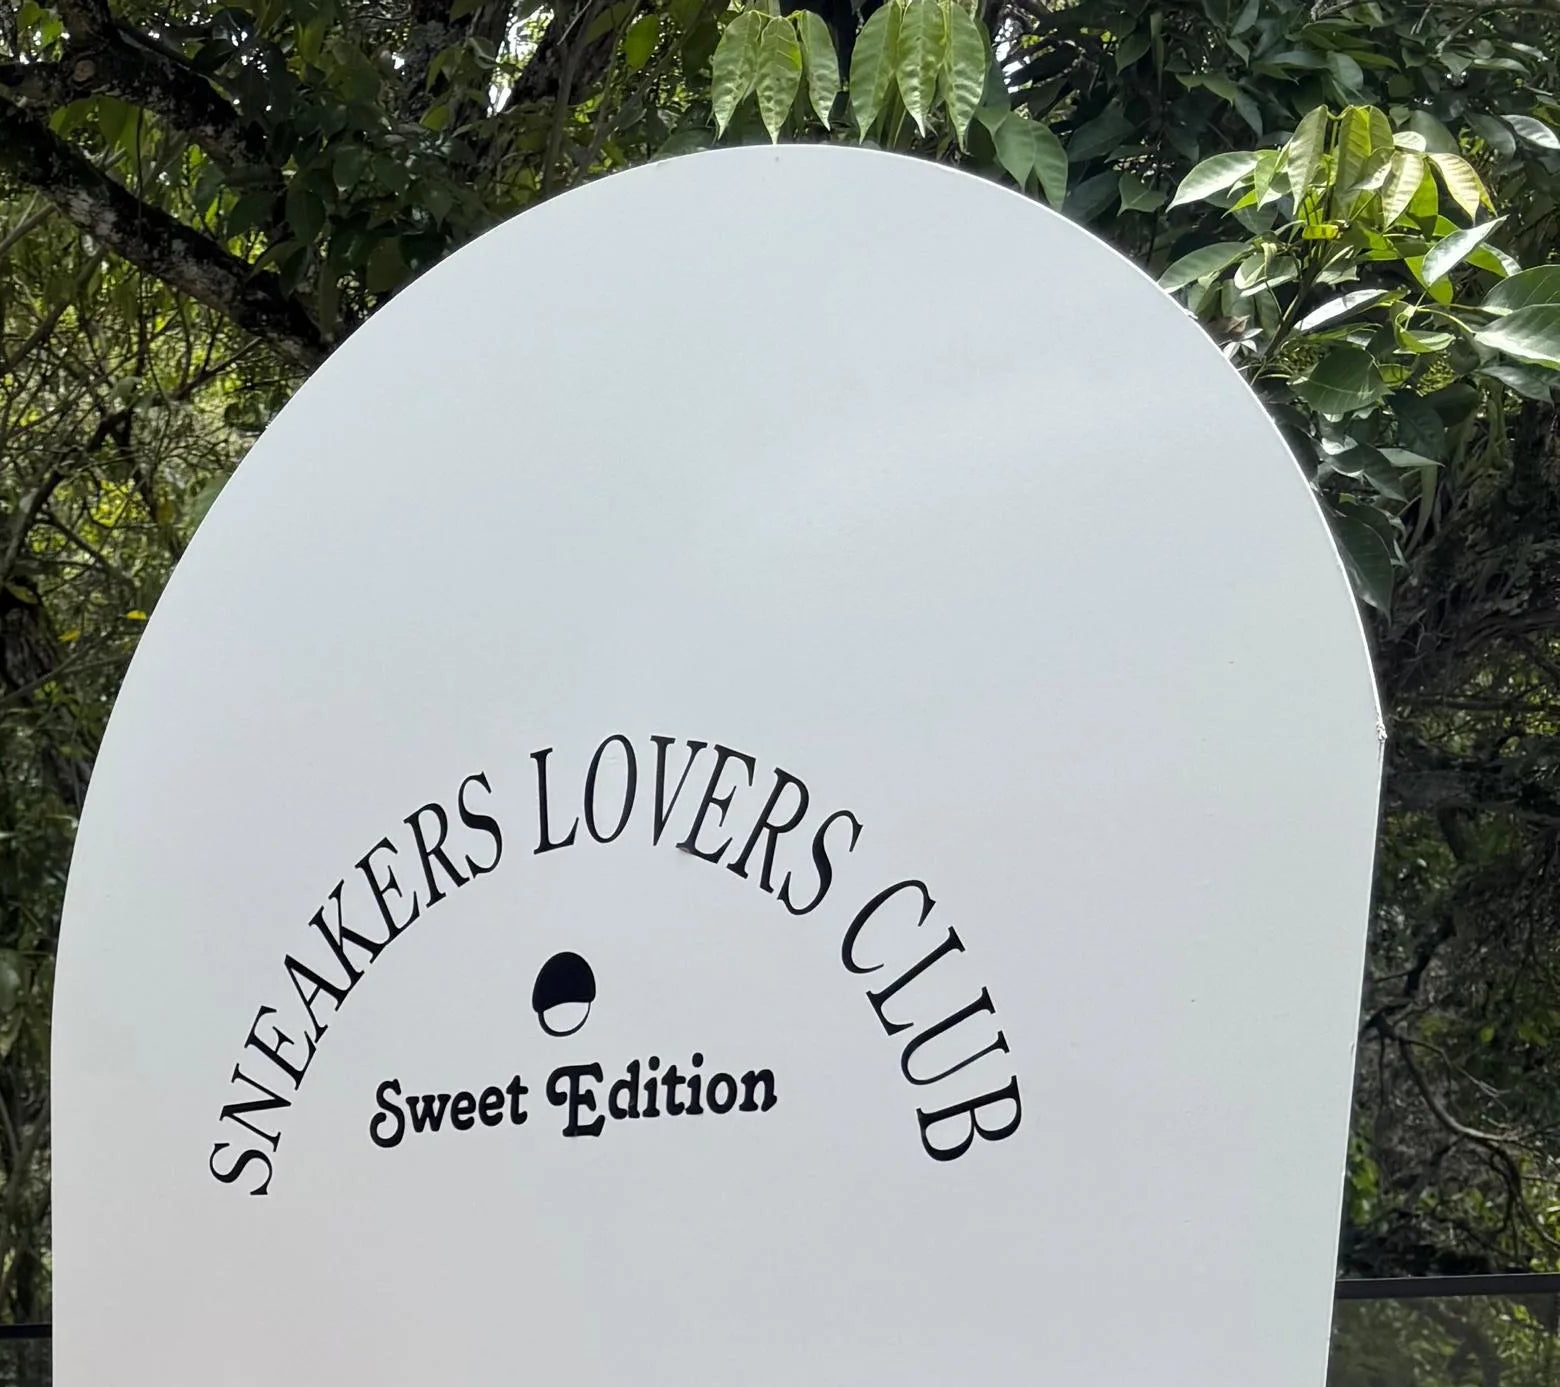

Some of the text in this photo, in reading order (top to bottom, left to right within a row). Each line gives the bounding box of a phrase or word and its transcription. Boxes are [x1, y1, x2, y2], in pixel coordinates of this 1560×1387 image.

[209, 734, 1022, 1196] SNEAKERS LOVERS CLUB
[369, 1052, 778, 1149] Sweet Edition
